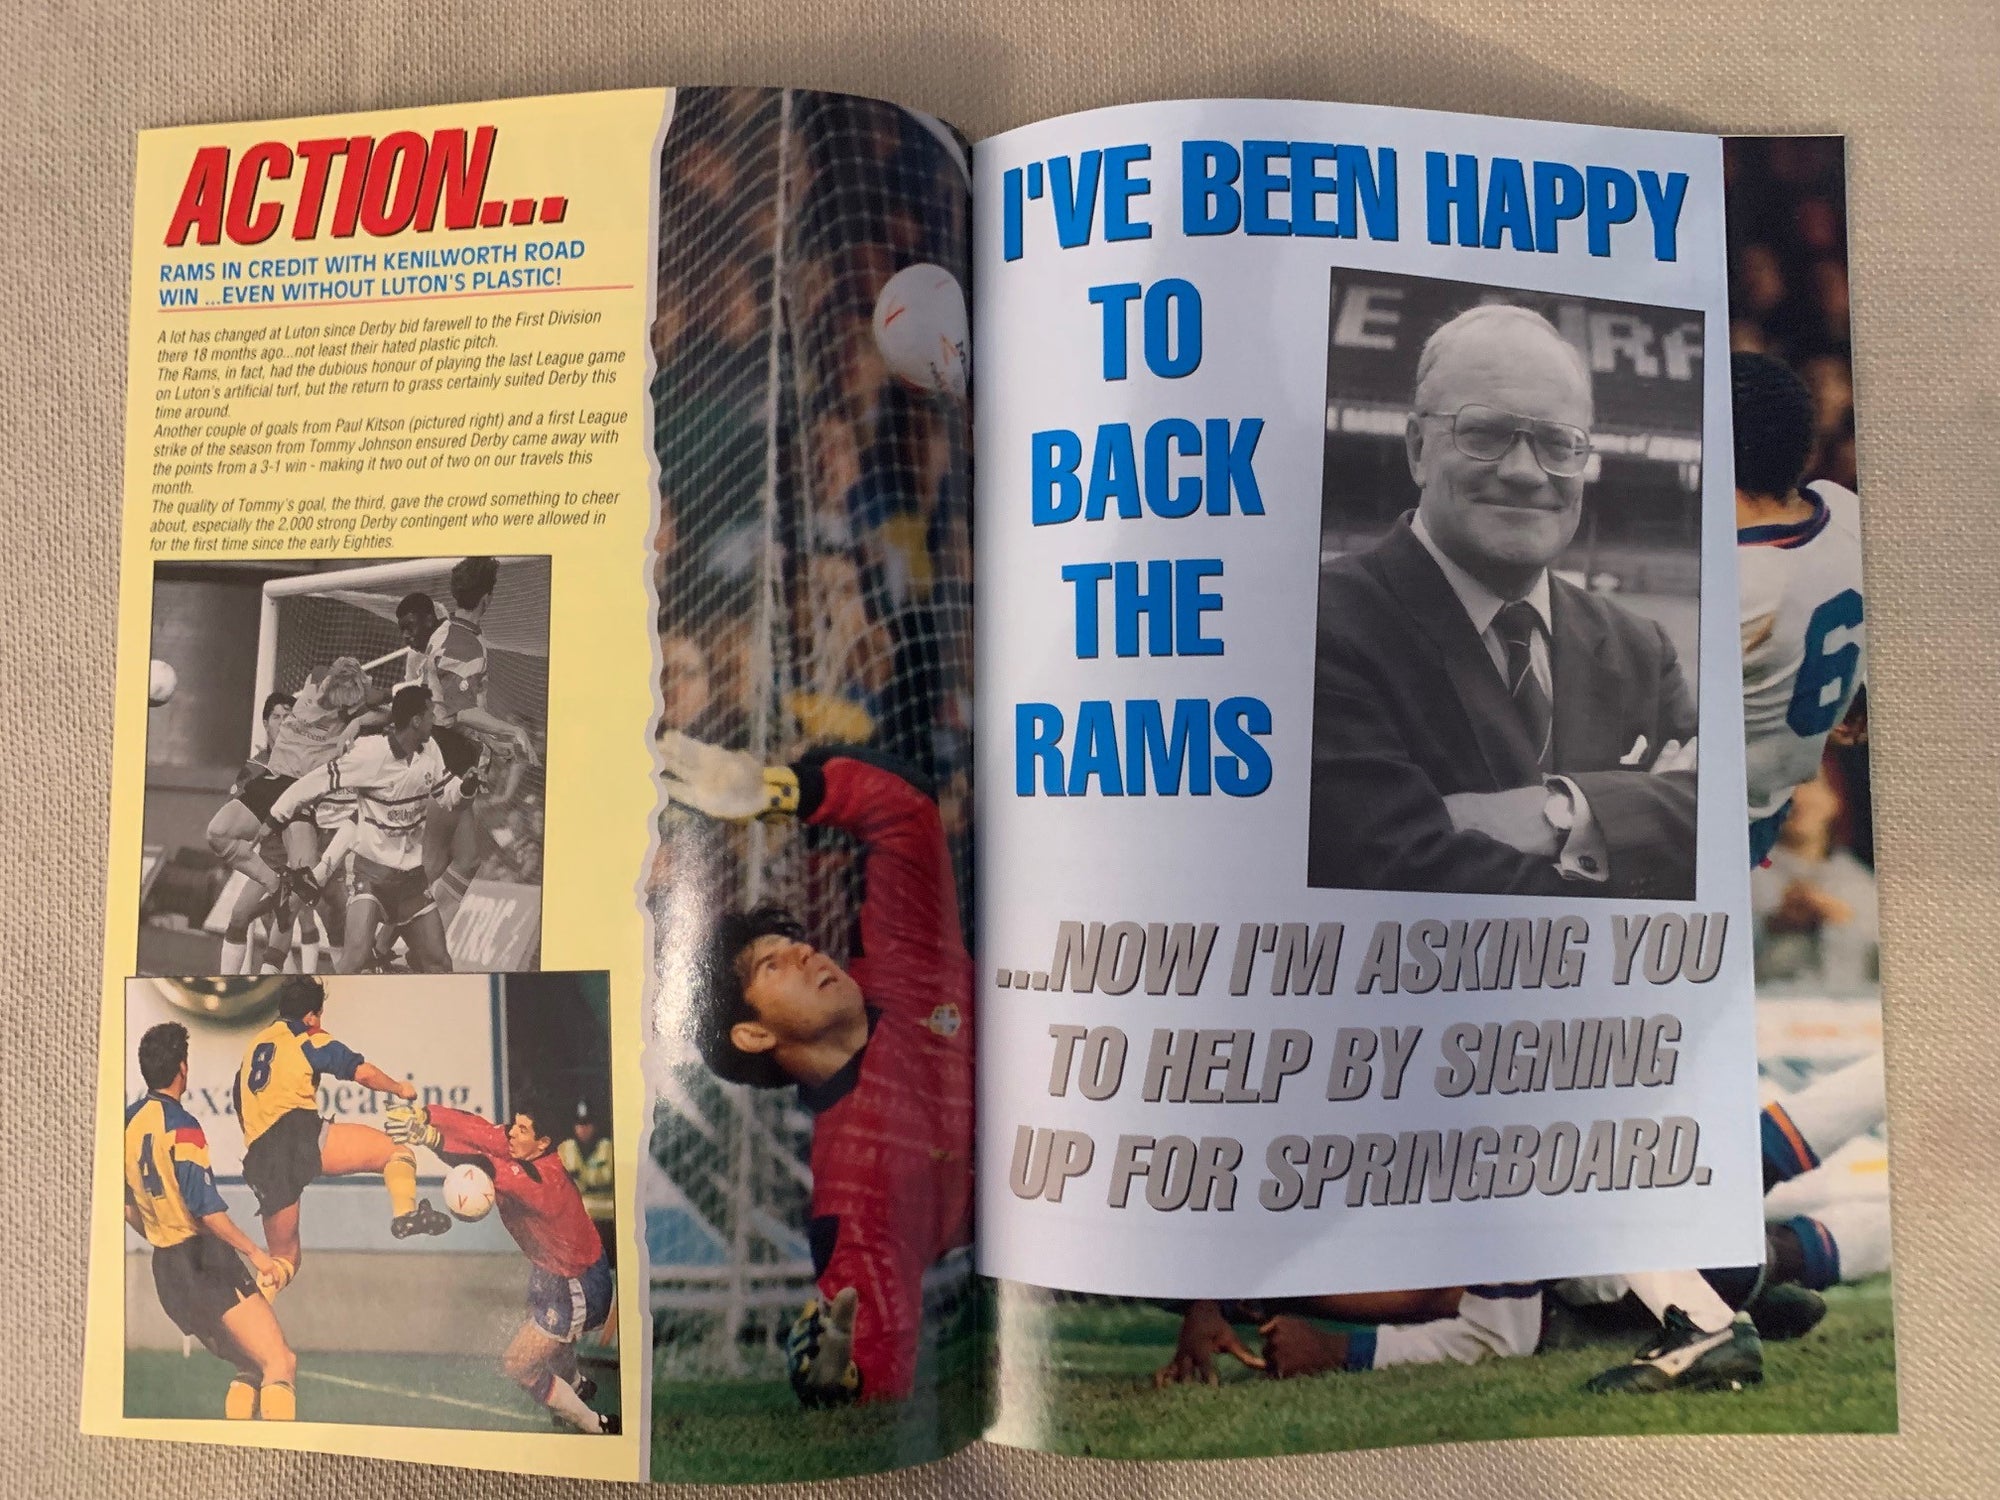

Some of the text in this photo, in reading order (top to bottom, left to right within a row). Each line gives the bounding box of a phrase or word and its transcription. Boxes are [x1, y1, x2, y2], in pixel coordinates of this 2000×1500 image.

[163, 125, 568, 247] ACTION...
[1003, 140, 1689, 262] I'VE BEEN HAPPY
[160, 240, 585, 282] RAMS IN CREDIT WITH KENILWORTH ROAD
[159, 288, 198, 306] WIN
[281, 279, 375, 301] WITHOUT
[381, 272, 465, 296] LUTON'S
[473, 267, 561, 290] PLASTIC!
[156, 309, 602, 344] A lot has changed at Luton since Derby bid farewell to the First Division
[1088, 278, 1203, 382] TO
[157, 348, 188, 363] there
[193, 347, 208, 362] 18
[210, 346, 257, 361] months
[318, 342, 347, 357] least
[350, 340, 378, 355] their
[381, 337, 417, 353] hated
[418, 335, 460, 355] plastic
[462, 333, 497, 352] pitch.
[158, 366, 179, 381] The
[224, 365, 237, 379] in
[269, 363, 293, 378] had
[295, 362, 315, 376] the
[318, 360, 368, 376] dubious
[371, 359, 416, 373] honour
[419, 355, 434, 371] of
[434, 355, 482, 373] playing
[485, 353, 506, 368] the
[508, 351, 533, 366] last
[535, 350, 584, 368] League
[586, 350, 626, 367] game
[155, 389, 171, 401] on
[174, 385, 220, 400] Luton's
[223, 383, 273, 399] artificial
[304, 381, 326, 396] but
[328, 380, 348, 395] the
[350, 379, 389, 394] return
[392, 378, 405, 392] to
[407, 378, 443, 394] grass
[446, 372, 501, 390] certainly
[503, 370, 545, 387] suited
[547, 369, 588, 387] Derby
[591, 368, 616, 384] this
[153, 408, 628, 439] Another couple of goals from Paul Kitson (pictured right) and a first League
[154, 403, 230, 419] time around.
[152, 429, 619, 457] strike of the season from Tommy Johnson ensured Derby came away with
[152, 461, 172, 476] the
[174, 461, 213, 478] points
[216, 460, 246, 475] from
[249, 462, 257, 474] a
[260, 458, 280, 474] 3-1
[285, 458, 307, 473] win
[318, 457, 364, 474] making
[367, 456, 376, 471] it
[379, 456, 403, 470] two
[405, 455, 427, 469] out
[429, 453, 444, 469] of
[446, 454, 470, 468] two
[473, 454, 490, 467] on
[493, 454, 516, 466] our
[519, 450, 564, 465] travels
[567, 449, 593, 464] this
[1031, 417, 1265, 526] BACK
[151, 480, 193, 495] month.
[152, 498, 174, 513] The
[176, 498, 218, 516] quality
[221, 498, 235, 513] of
[239, 497, 295, 515] Tommy's
[331, 496, 351, 510] the
[390, 496, 420, 512] gave
[423, 493, 444, 508] the
[446, 491, 488, 507] crowd
[489, 490, 560, 508] something
[564, 490, 578, 505] to
[581, 489, 620, 505] cheer
[191, 517, 252, 534] especially
[255, 517, 275, 531] the
[315, 516, 357, 532] strong
[360, 513, 398, 532] Derby
[400, 513, 468, 531] contingent
[471, 511, 499, 526] who
[502, 513, 534, 526] were
[536, 509, 590, 525] allowed
[592, 510, 606, 525] in
[149, 533, 393, 552] for the first time since the early Eighties.
[1061, 558, 1224, 659] THE
[1785, 588, 1863, 738] 6
[1015, 696, 1272, 798] RAMS
[996, 912, 1729, 997] ...NOW I'M ASKING YOU
[247, 1042, 276, 1095] 8
[1047, 1013, 1682, 1103] TO HELP BY SIGNING
[137, 1132, 166, 1199] 4
[1009, 1115, 1712, 1212] UP FOR SPRINGBOARD.
